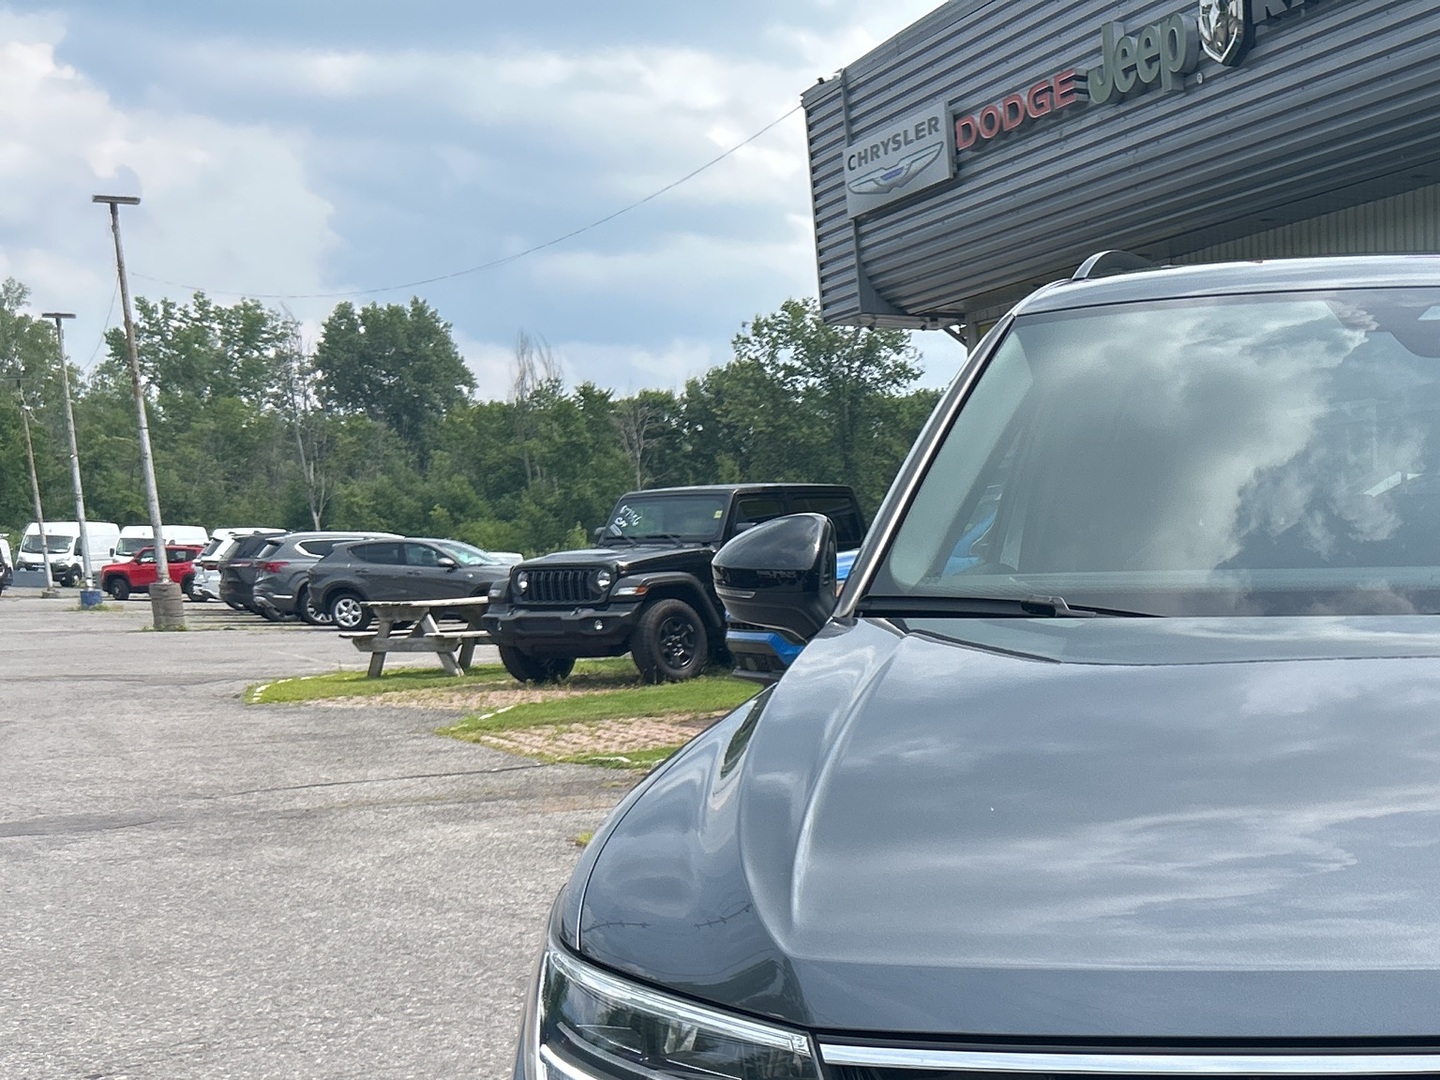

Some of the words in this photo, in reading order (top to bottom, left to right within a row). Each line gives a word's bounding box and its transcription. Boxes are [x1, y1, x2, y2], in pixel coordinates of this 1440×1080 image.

[1088, 12, 1186, 104] Jeep
[847, 116, 940, 172] CHRYSLER
[956, 68, 1077, 150] DODGE
